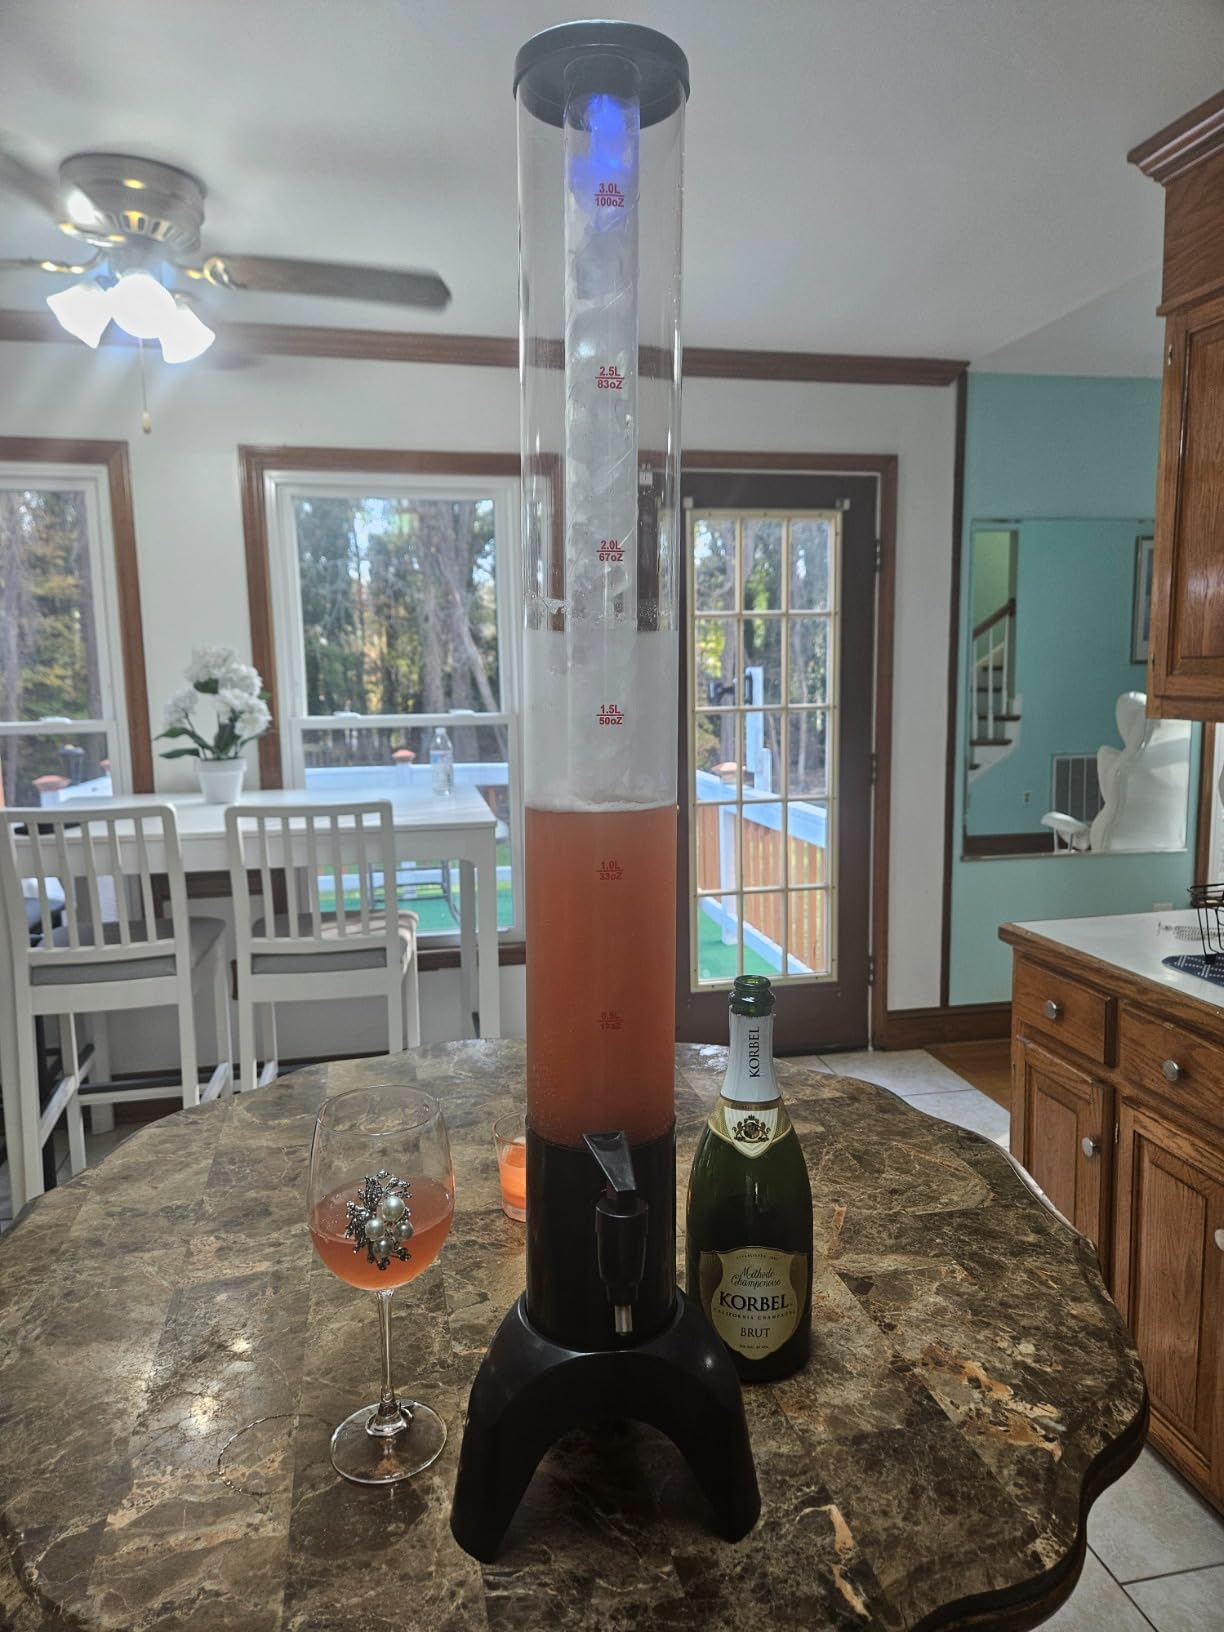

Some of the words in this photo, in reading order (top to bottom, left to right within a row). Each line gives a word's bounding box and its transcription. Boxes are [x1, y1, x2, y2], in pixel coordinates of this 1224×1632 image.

[599, 183, 621, 194] 3.0L
[595, 197, 625, 208] 100oZ
[599, 366, 621, 377] 2.5L
[597, 379, 623, 390] 83oZ
[600, 540, 621, 550] 2.0L
[599, 552, 624, 562] 67oZ
[600, 704, 621, 714] 1.5L
[599, 716, 623, 725] 50oZ
[600, 860, 621, 870] 1.0L
[748, 1026, 760, 1078] KORBEL
[719, 1291, 789, 1312] KORBEL
[740, 1327, 771, 1338] BRUT
